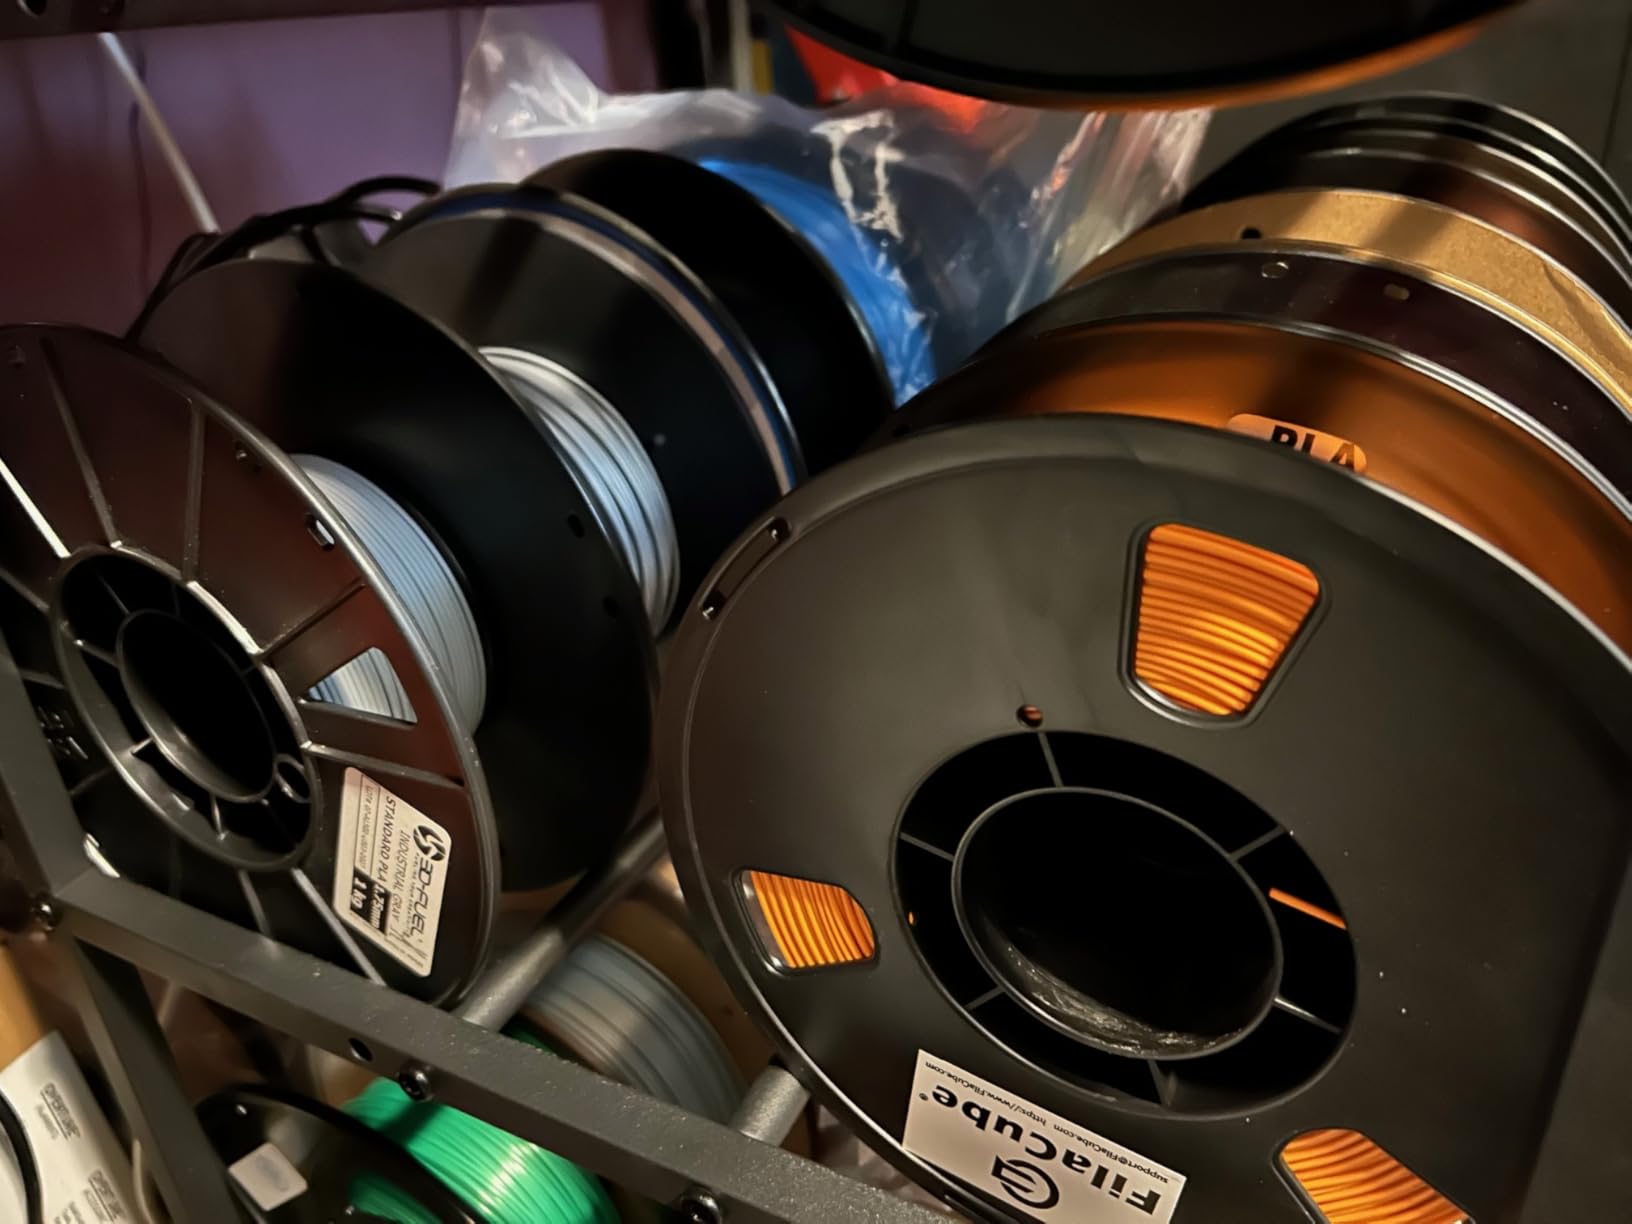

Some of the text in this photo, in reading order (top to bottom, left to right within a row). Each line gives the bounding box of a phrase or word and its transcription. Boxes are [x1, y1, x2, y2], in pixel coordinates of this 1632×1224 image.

[378, 796, 396, 882] STANDARD PLA
[390, 830, 410, 920] INDUSTRIAL GRAY
[352, 889, 365, 909] kg
[357, 878, 366, 889] 1
[370, 883, 385, 927] 1.75mm
[409, 857, 432, 938] 3D-FUEL
[925, 1061, 1169, 1184] support@FilaCube.com https://www.FilaCube.com
